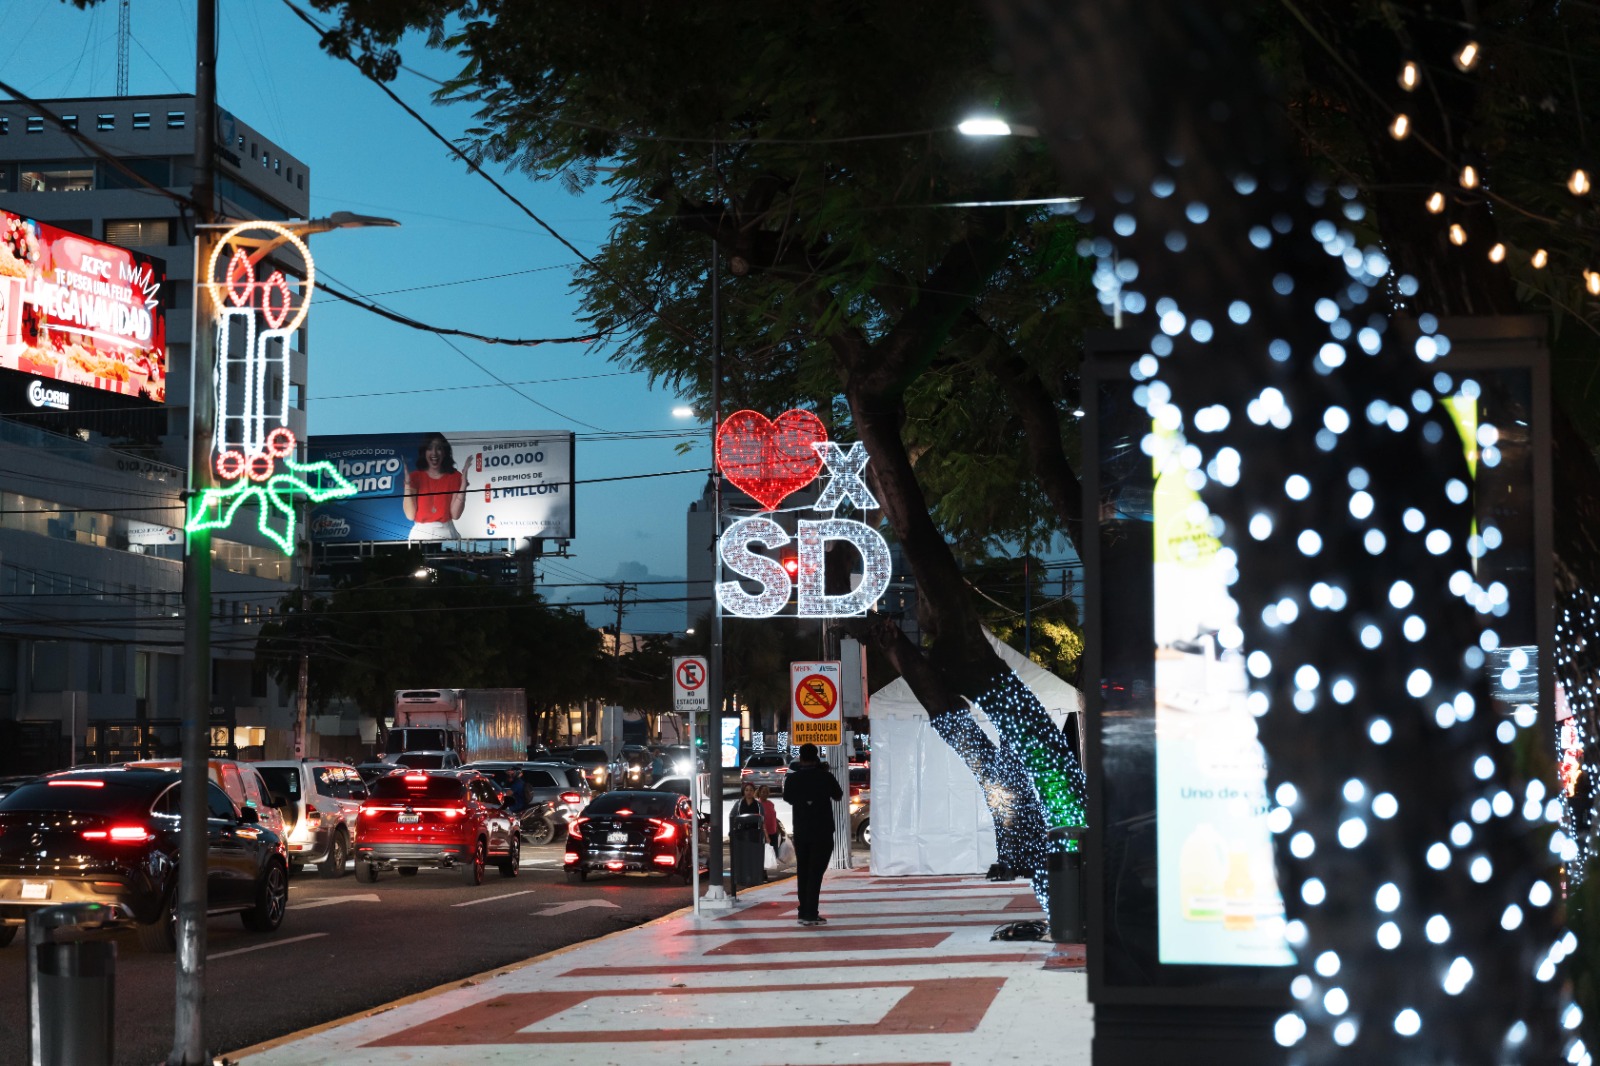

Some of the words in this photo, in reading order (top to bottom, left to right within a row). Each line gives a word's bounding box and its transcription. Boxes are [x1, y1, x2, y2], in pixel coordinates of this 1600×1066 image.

[82, 254, 112, 279] KFC
[55, 267, 66, 286] TE
[67, 270, 93, 293] DESEA
[94, 280, 111, 299] UNA
[111, 283, 133, 305] FELIZ
[326, 451, 341, 459] Haz
[342, 446, 374, 457] espacio
[375, 448, 395, 457] para
[494, 441, 527, 451] PREMIOS
[484, 451, 544, 468] 100,000
[498, 473, 532, 482] PREMIOS
[493, 488, 499, 499] 1
[503, 480, 559, 498] MILLÓN
[716, 517, 892, 619] SD
[795, 722, 804, 732] NO
[806, 722, 838, 732] BLOQUEAR
[795, 733, 838, 743] INTERSECCION
[1180, 787, 1214, 800] Uno
[1217, 787, 1239, 799] de
